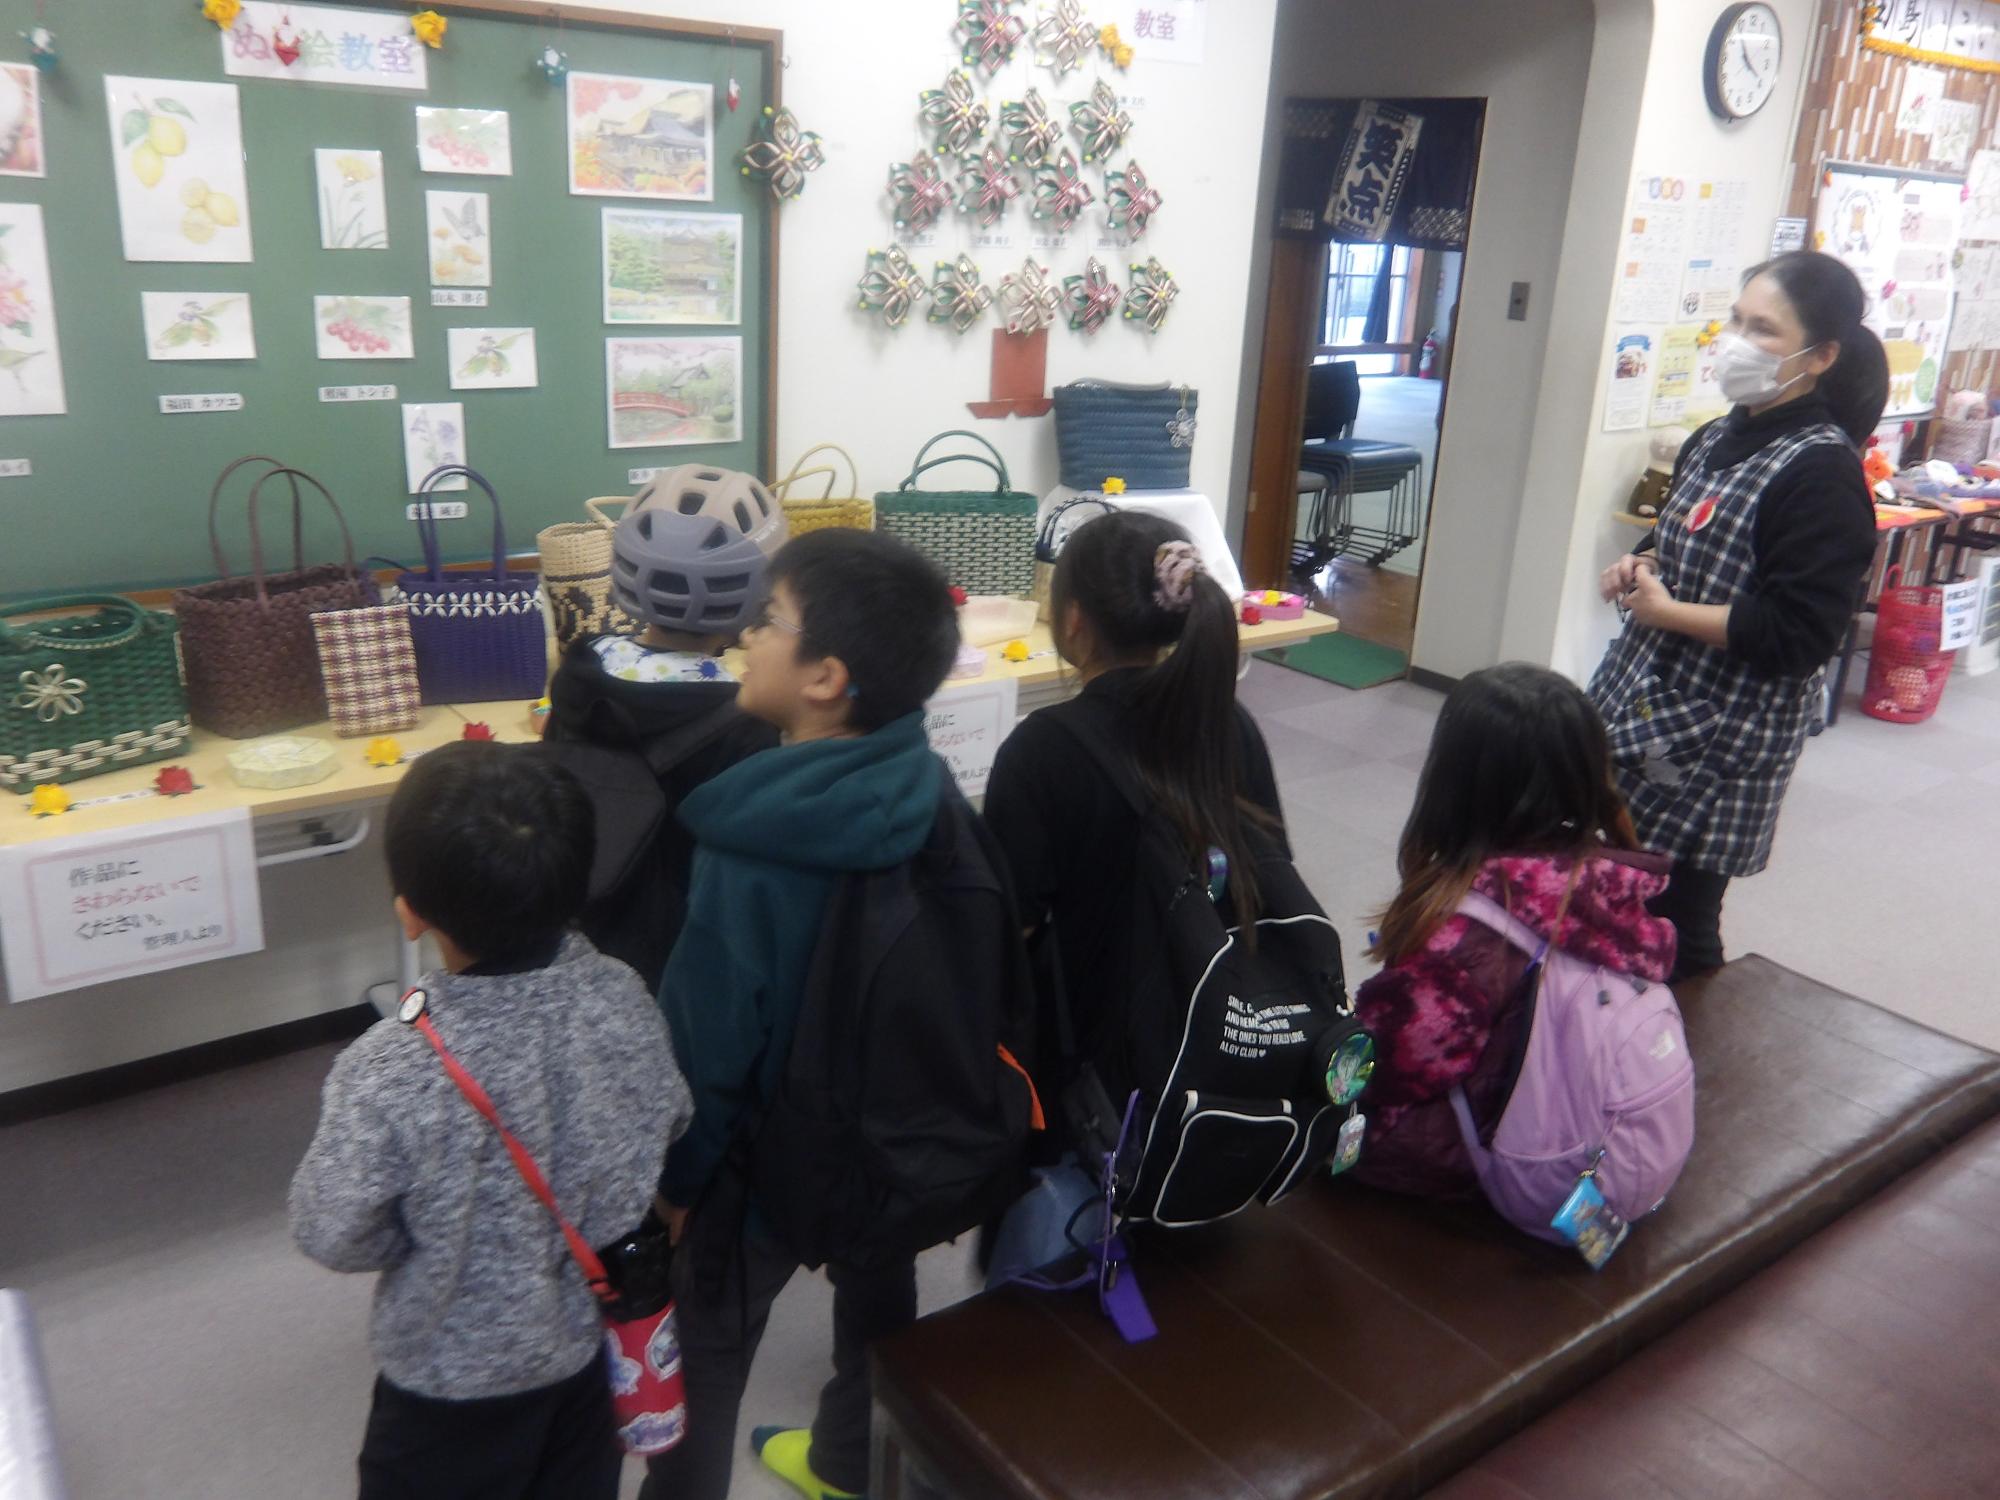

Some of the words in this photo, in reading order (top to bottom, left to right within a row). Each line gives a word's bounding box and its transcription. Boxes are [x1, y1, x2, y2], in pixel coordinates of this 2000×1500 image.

[232, 21, 415, 75] ぬ絵教室
[68, 860, 142, 888] 作品に
[1223, 1025, 1239, 1041] THE
[1238, 1030, 1257, 1045] ONES
[1258, 1033, 1273, 1046] YOU
[1239, 1047, 1259, 1059] CLUB
